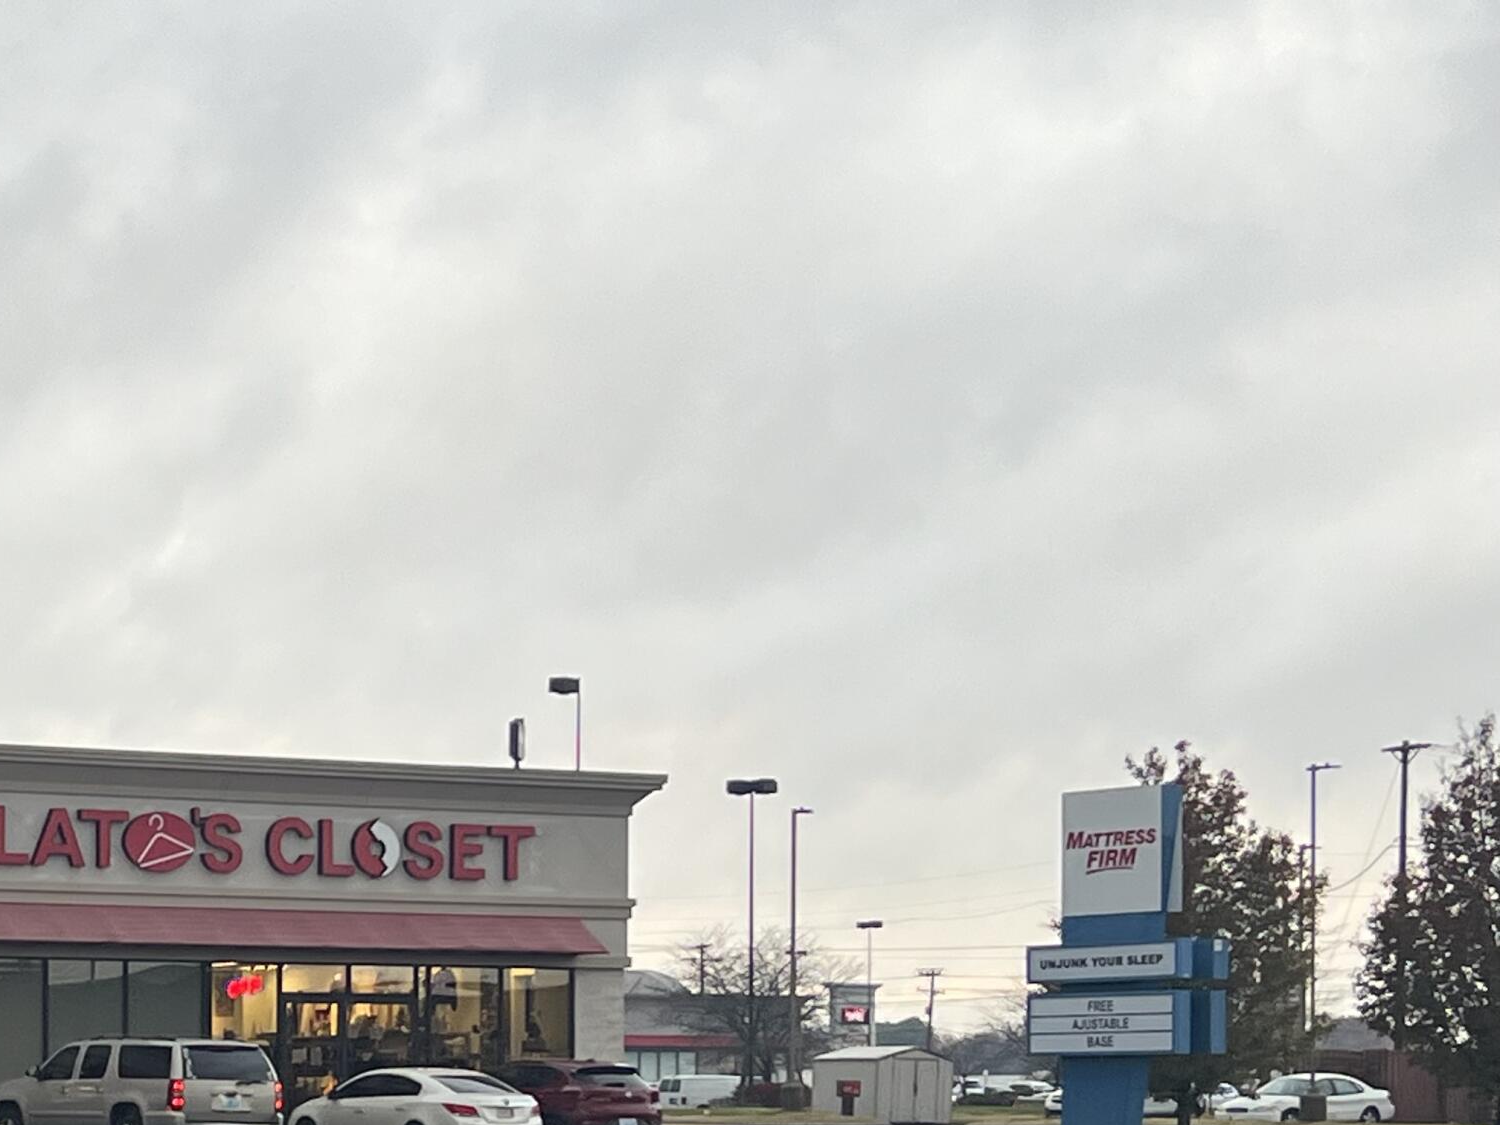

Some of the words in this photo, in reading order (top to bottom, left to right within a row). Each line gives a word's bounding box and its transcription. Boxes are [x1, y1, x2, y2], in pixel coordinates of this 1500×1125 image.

[1066, 828, 1157, 850] MATTRESS
[265, 817, 536, 881] CLOSET
[1086, 848, 1138, 869] FIRM
[1040, 958, 1088, 970] UNJUNK
[1091, 955, 1125, 967] YOUR
[1127, 953, 1164, 966] SLEEP
[1087, 1000, 1114, 1012] FREE
[1072, 1017, 1130, 1030] AJUSTABLE
[1087, 1035, 1114, 1048] BASE
